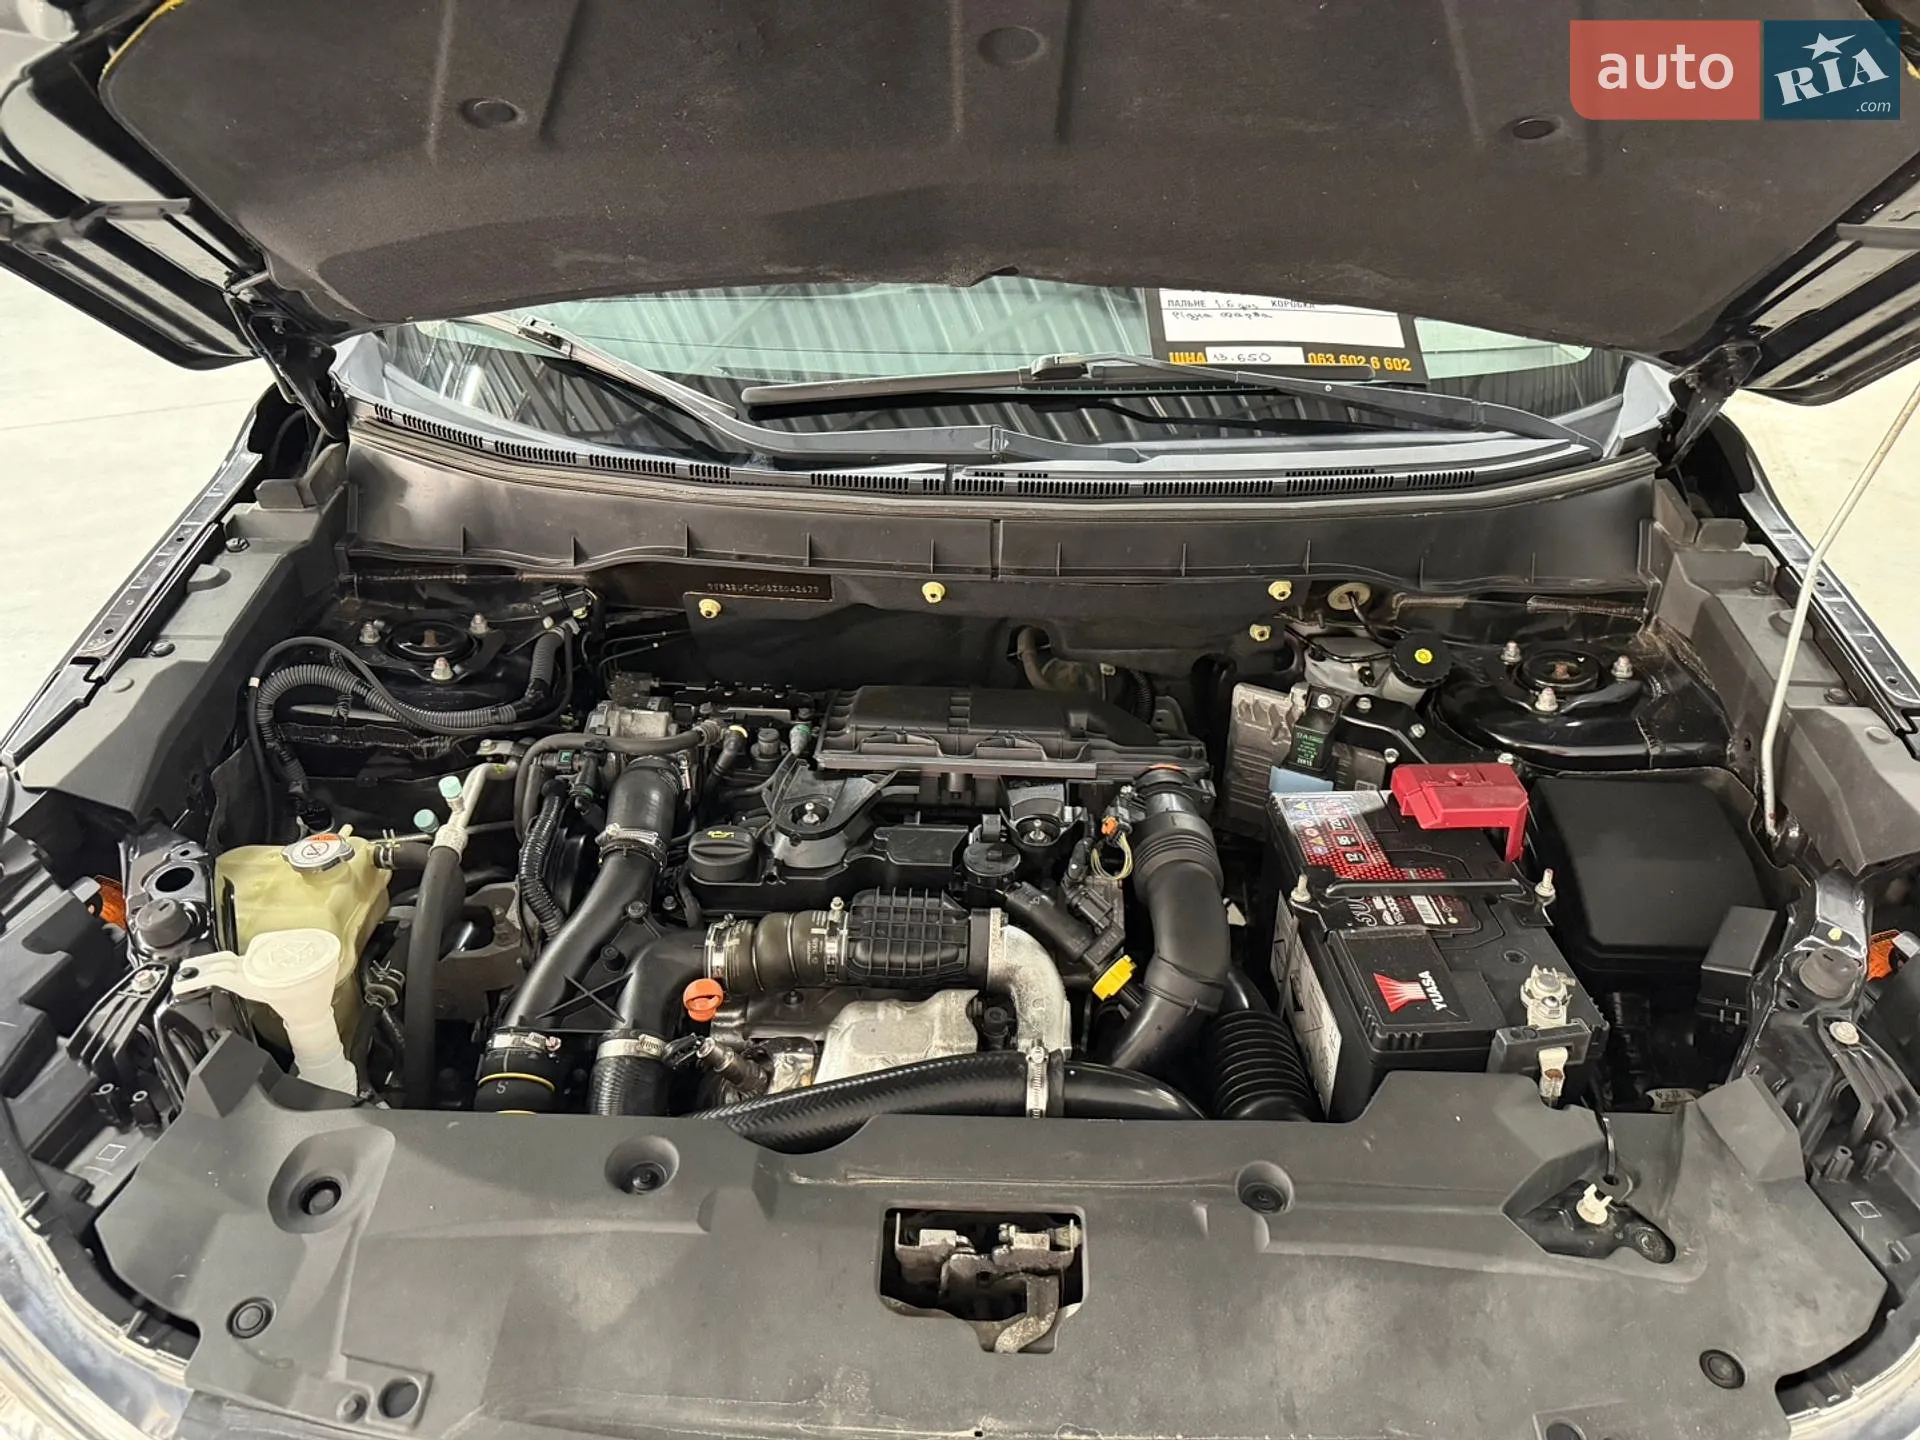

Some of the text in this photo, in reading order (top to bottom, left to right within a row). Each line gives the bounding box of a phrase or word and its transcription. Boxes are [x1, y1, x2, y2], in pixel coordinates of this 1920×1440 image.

[1167, 299, 1206, 308] ПАЛЬНЕ
[1308, 352, 1335, 365] 063
[1370, 356, 1381, 370] 6
[1384, 357, 1412, 372] 602
[1418, 970, 1448, 1011] YUASA
